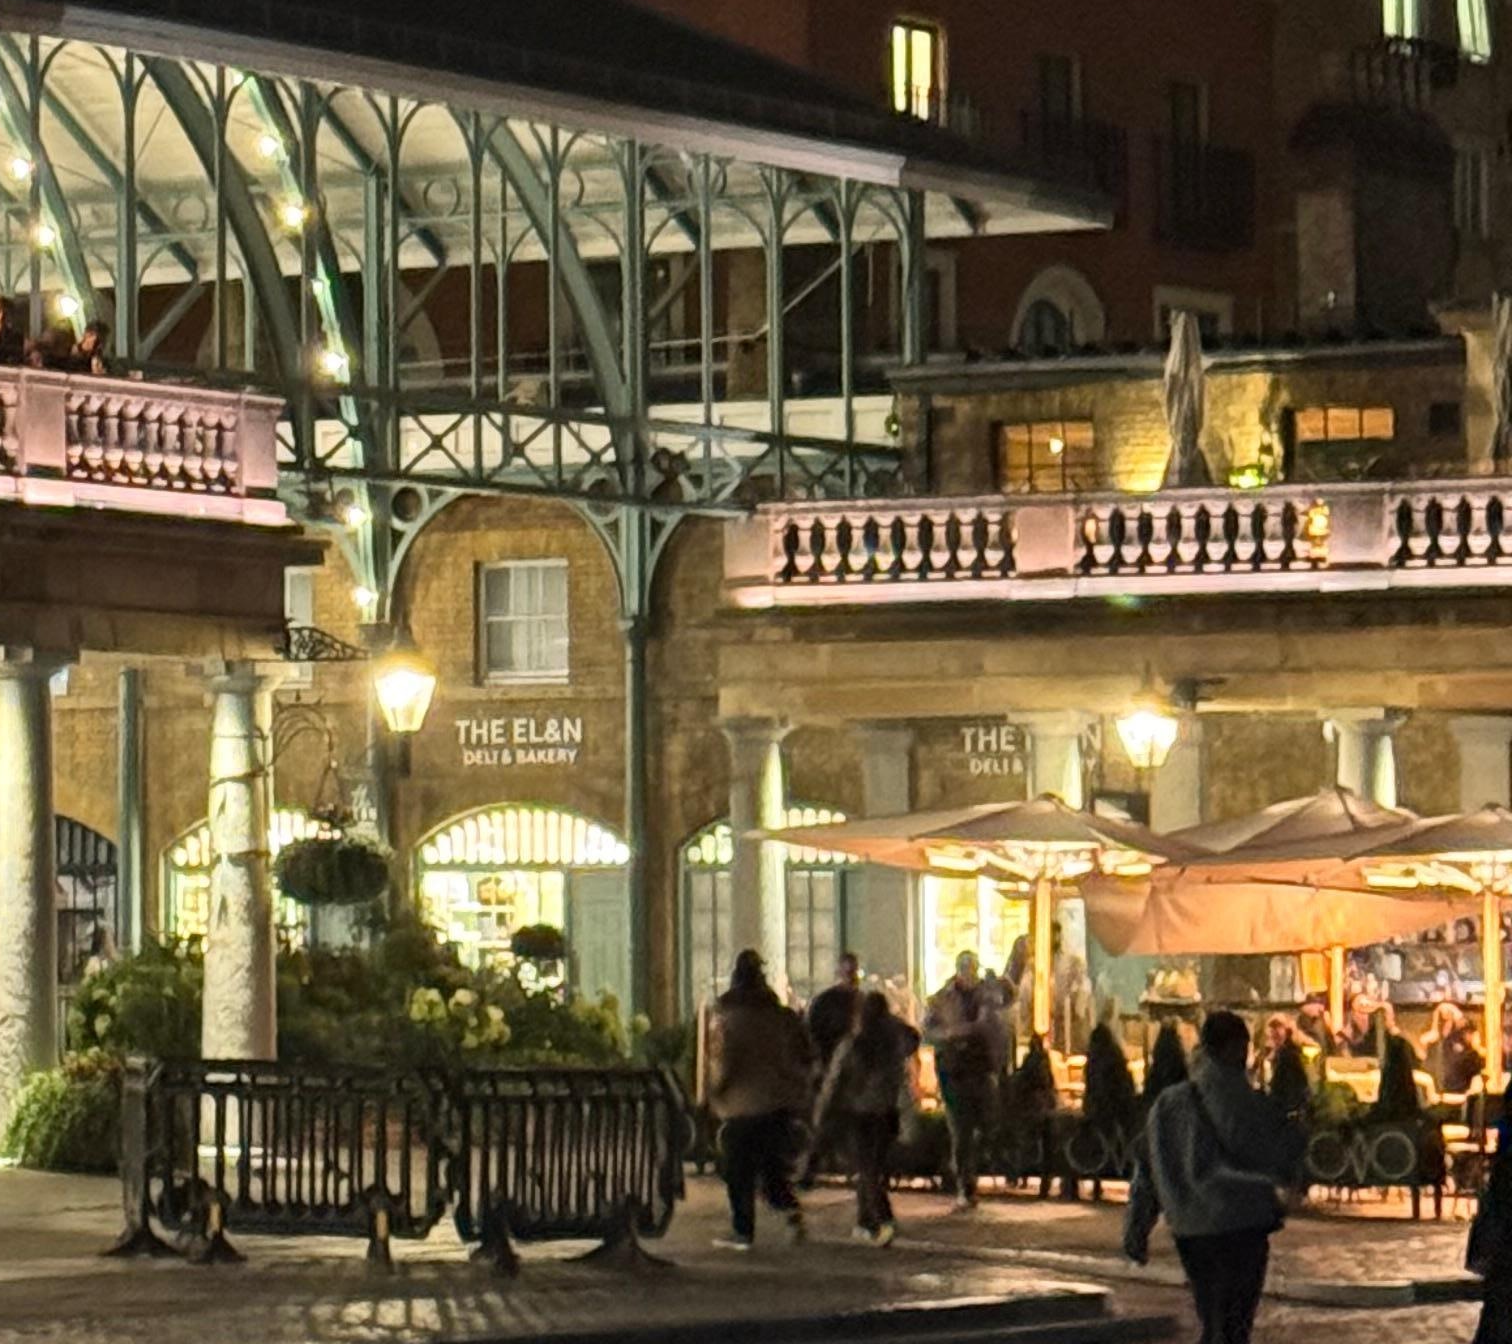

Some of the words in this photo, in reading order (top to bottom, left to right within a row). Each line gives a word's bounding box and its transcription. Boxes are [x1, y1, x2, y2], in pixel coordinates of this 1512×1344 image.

[455, 719, 506, 744] THE
[512, 718, 582, 744] EL&N
[960, 725, 1016, 753] THE
[463, 749, 498, 766] DELI
[516, 747, 577, 765] BAKERY
